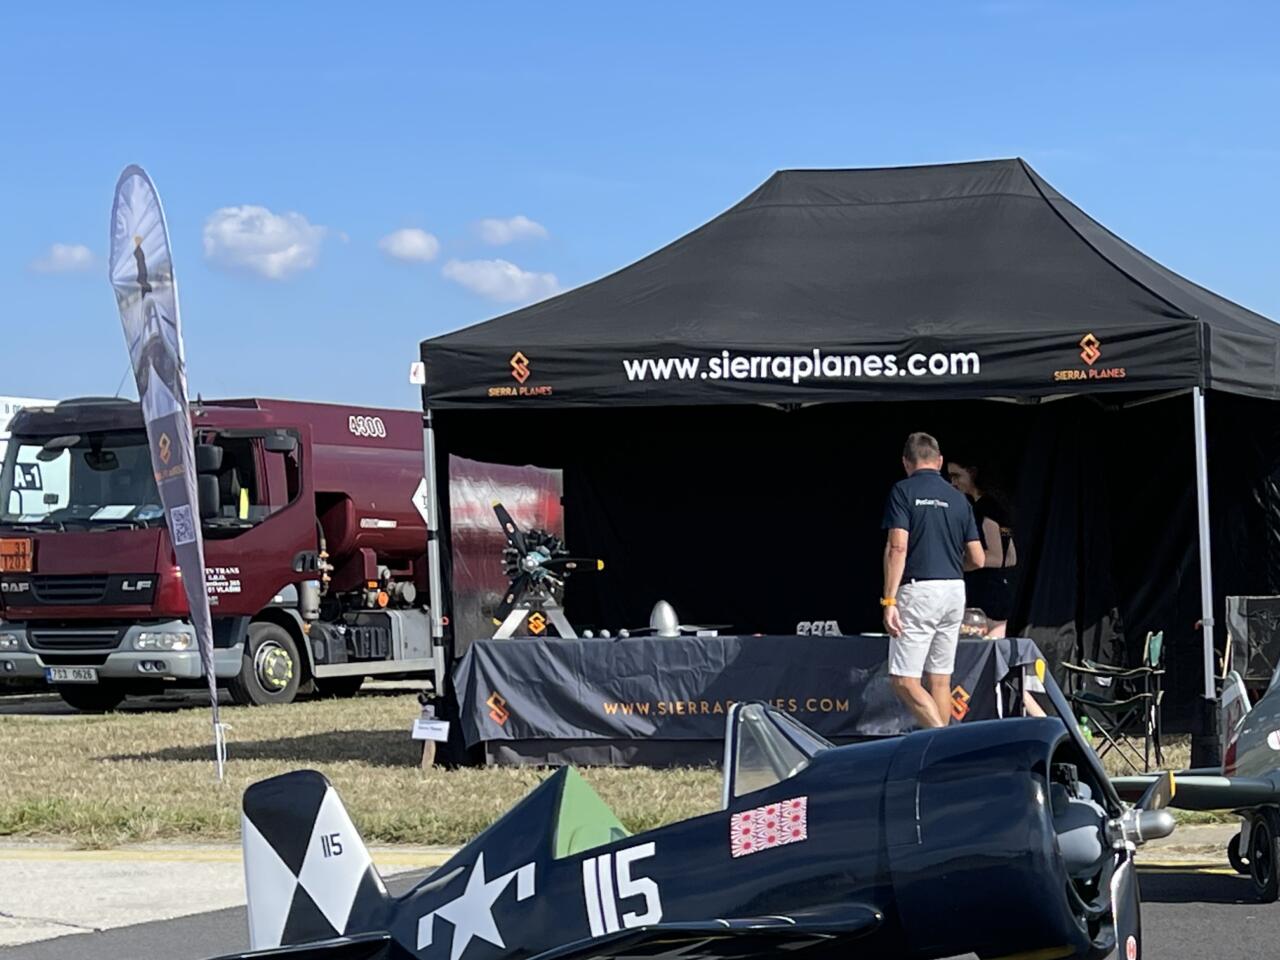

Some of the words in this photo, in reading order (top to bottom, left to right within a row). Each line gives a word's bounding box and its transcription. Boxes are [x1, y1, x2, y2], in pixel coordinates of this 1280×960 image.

[623, 348, 980, 384] www.sierraplanes.com
[1054, 369, 1087, 380] SIERRA
[1088, 367, 1127, 379] PLANES
[488, 386, 518, 397] SIERRA
[519, 386, 553, 396] PLANES
[349, 415, 387, 438] 4300
[14, 463, 42, 488] A-1
[15, 541, 27, 554] 33
[1, 582, 30, 592] DAF
[121, 580, 153, 591] LF
[321, 833, 343, 858] 115
[582, 841, 663, 938] 115
